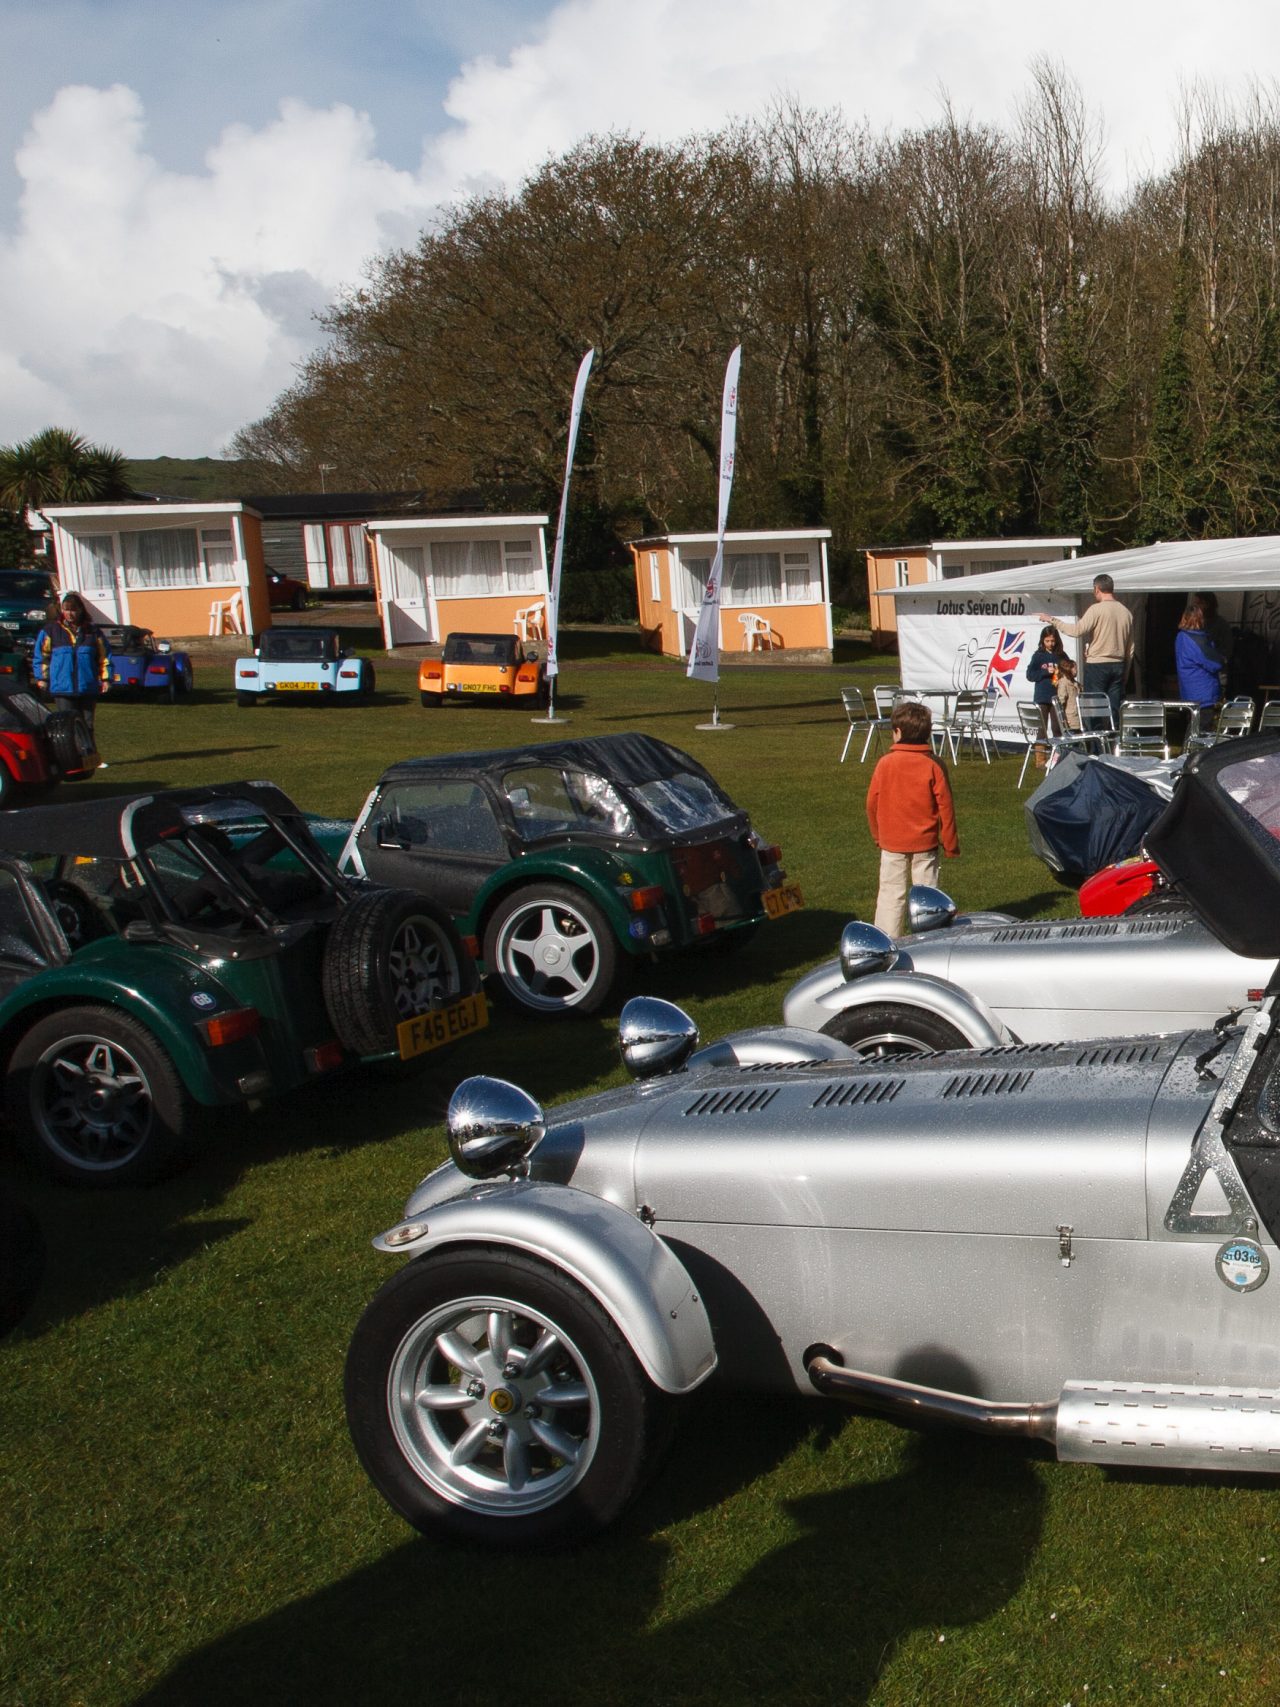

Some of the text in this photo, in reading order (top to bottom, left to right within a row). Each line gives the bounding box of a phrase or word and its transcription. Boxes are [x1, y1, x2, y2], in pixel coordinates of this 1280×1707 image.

[937, 597, 1026, 616] Lotus Seven Club
[193, 993, 213, 1006] GB
[410, 1000, 478, 1052] F46 EGJ
[1234, 1250, 1249, 1262] 03
